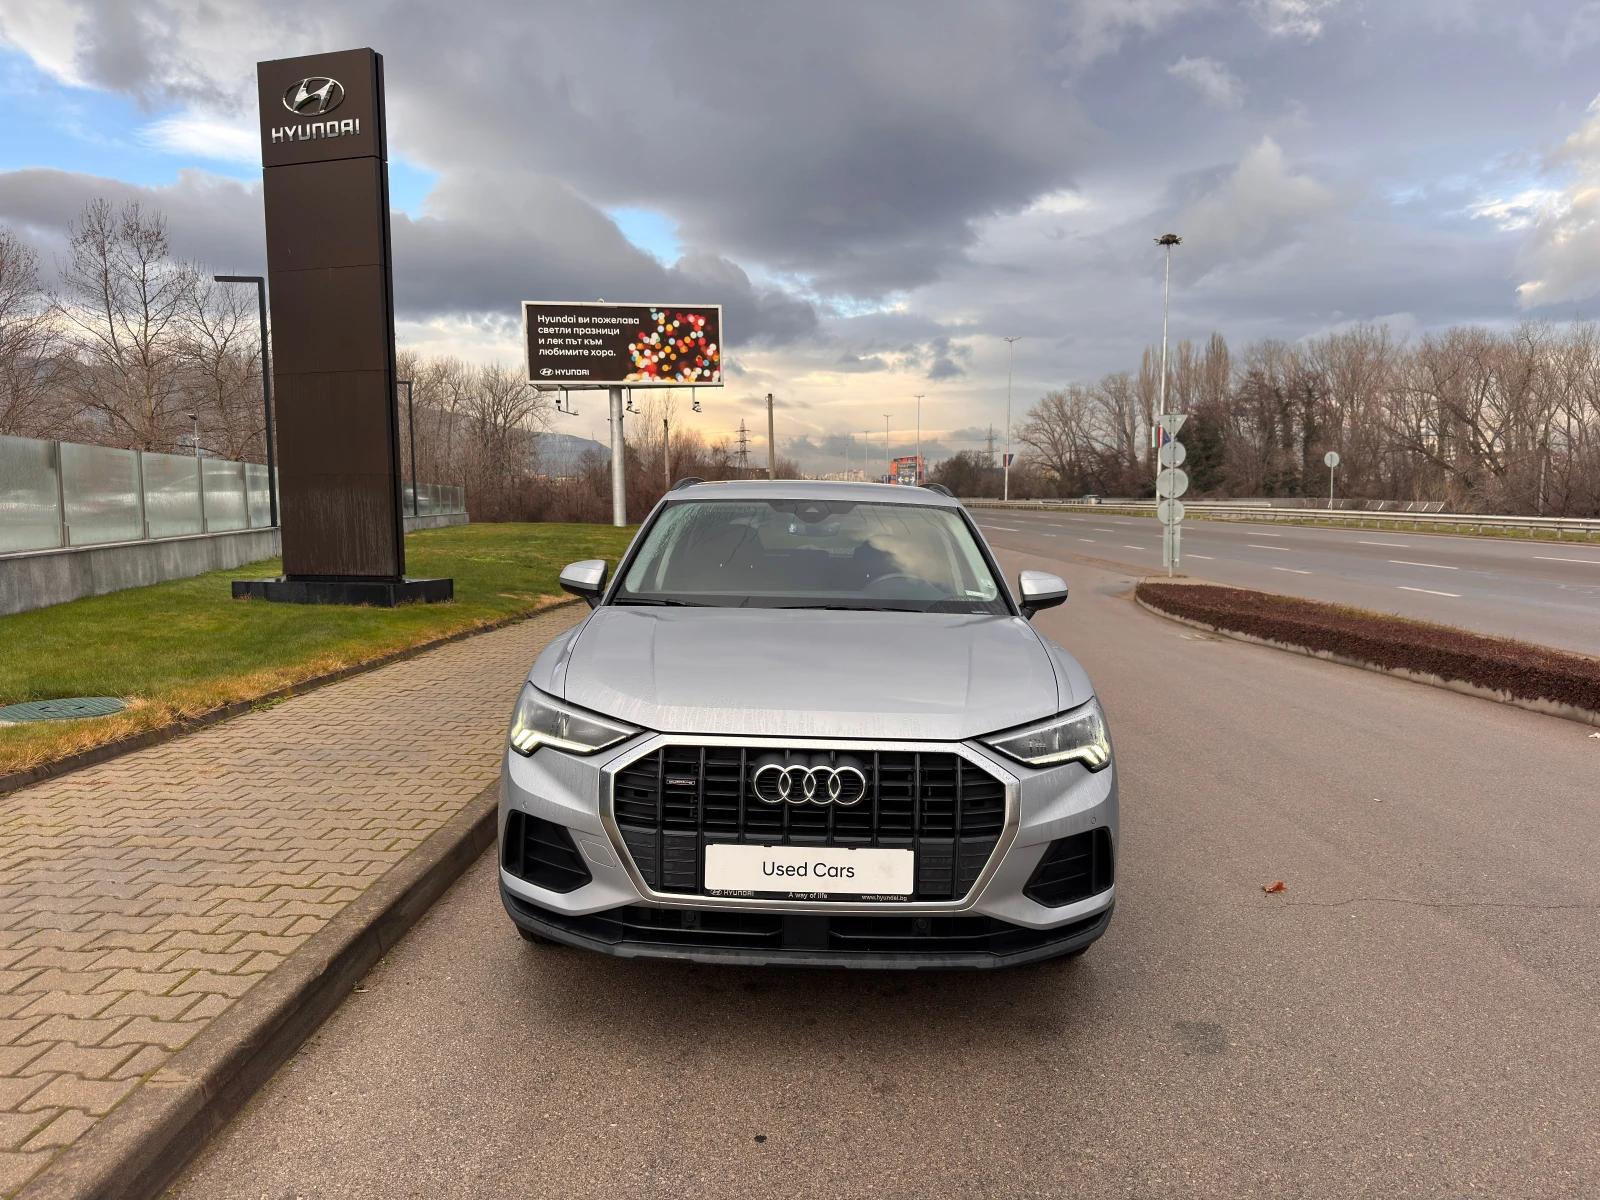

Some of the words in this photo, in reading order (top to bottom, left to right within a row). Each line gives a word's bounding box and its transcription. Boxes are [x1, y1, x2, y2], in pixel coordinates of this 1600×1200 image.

[272, 118, 361, 144] HYUNDAI
[537, 315, 577, 324] Hyundai
[573, 327, 620, 336] празници
[538, 347, 590, 356] любимите
[590, 349, 616, 357] хора.
[762, 861, 808, 877] Used
[813, 862, 855, 878] Cars
